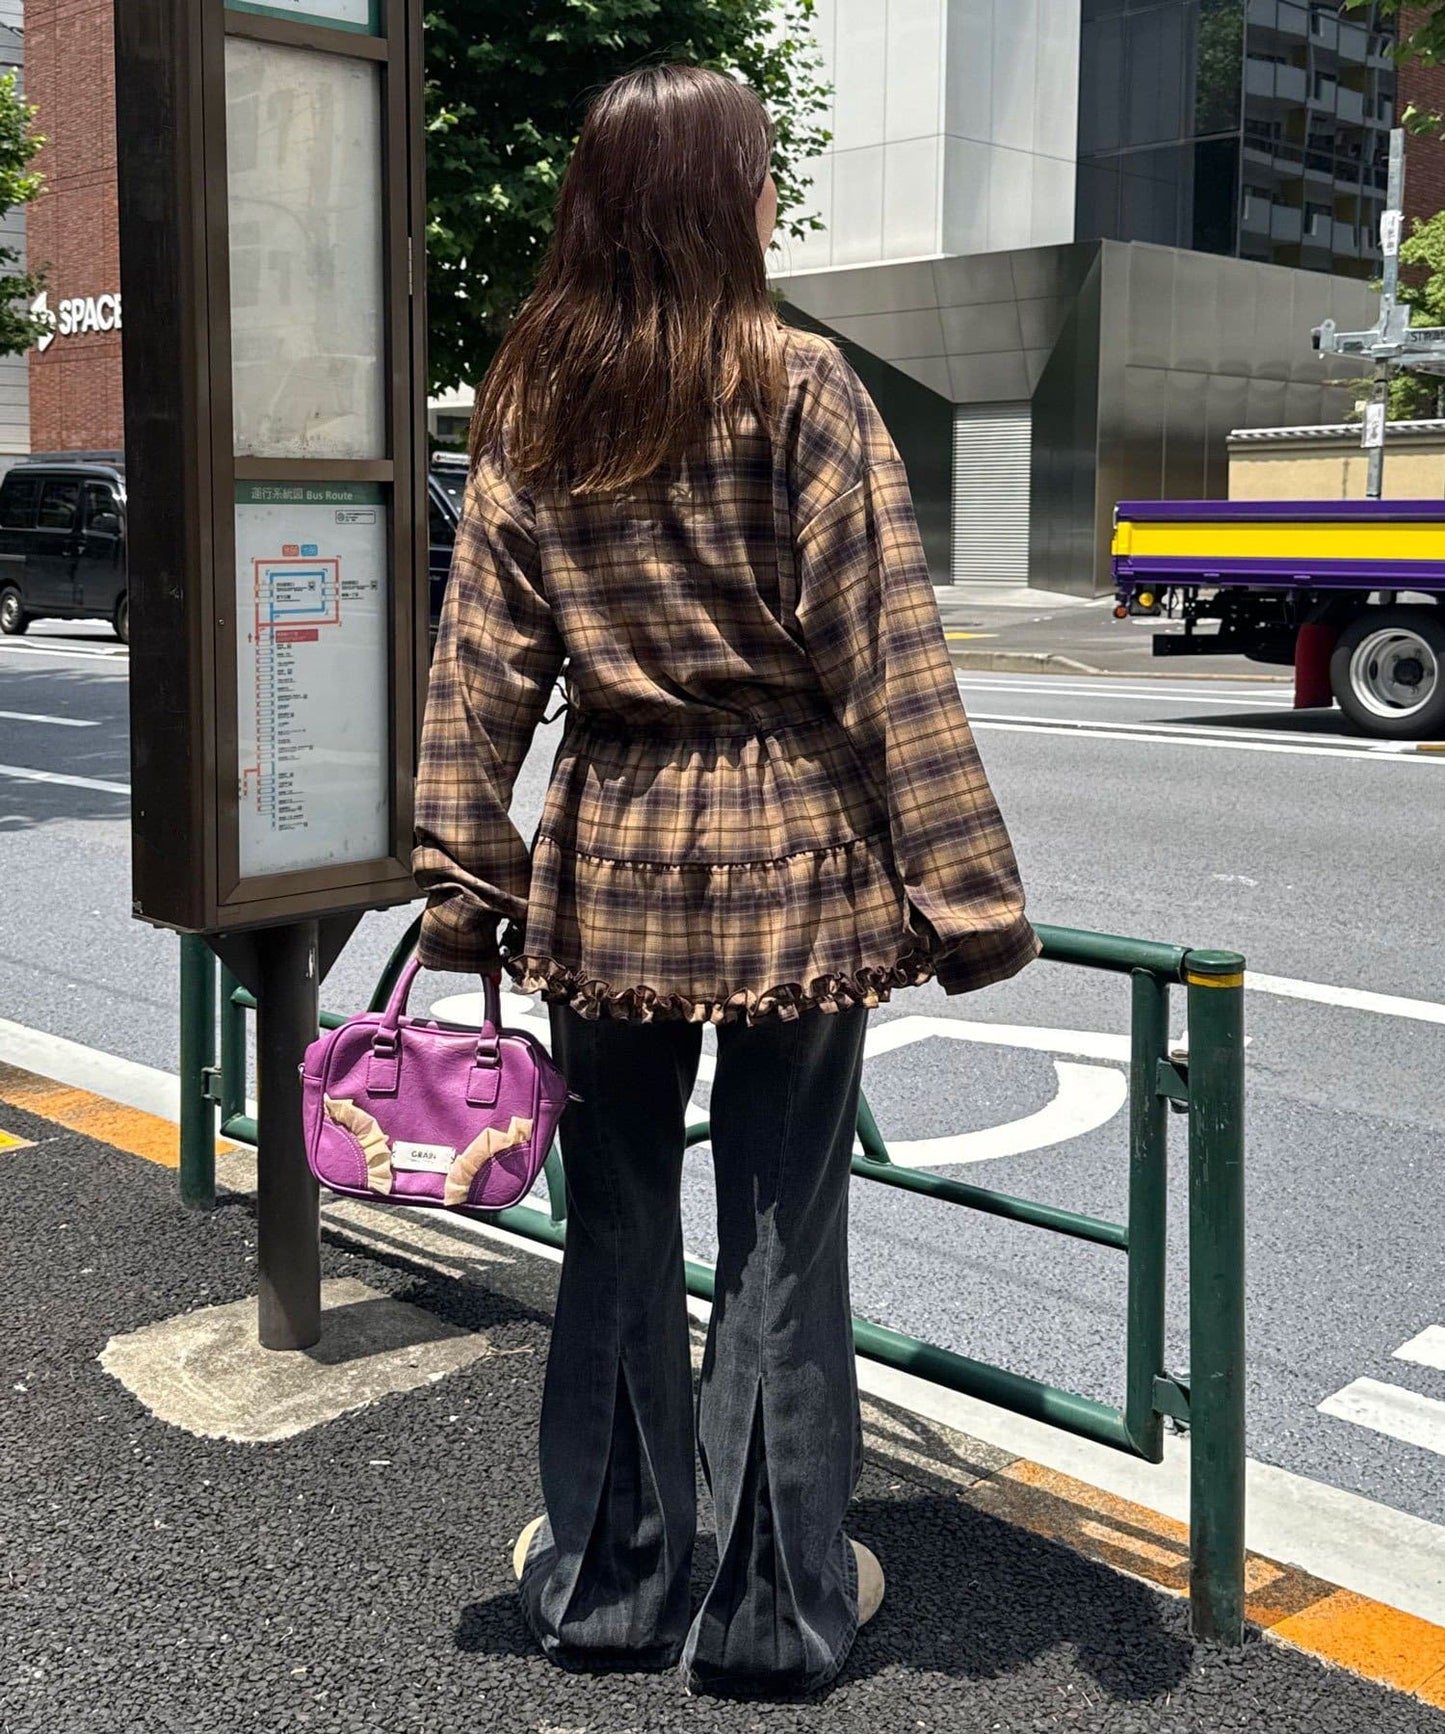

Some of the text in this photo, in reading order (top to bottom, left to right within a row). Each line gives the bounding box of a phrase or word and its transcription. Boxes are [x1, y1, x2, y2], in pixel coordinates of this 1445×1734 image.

[251, 487, 353, 500] 運行系統図 Bus Route
